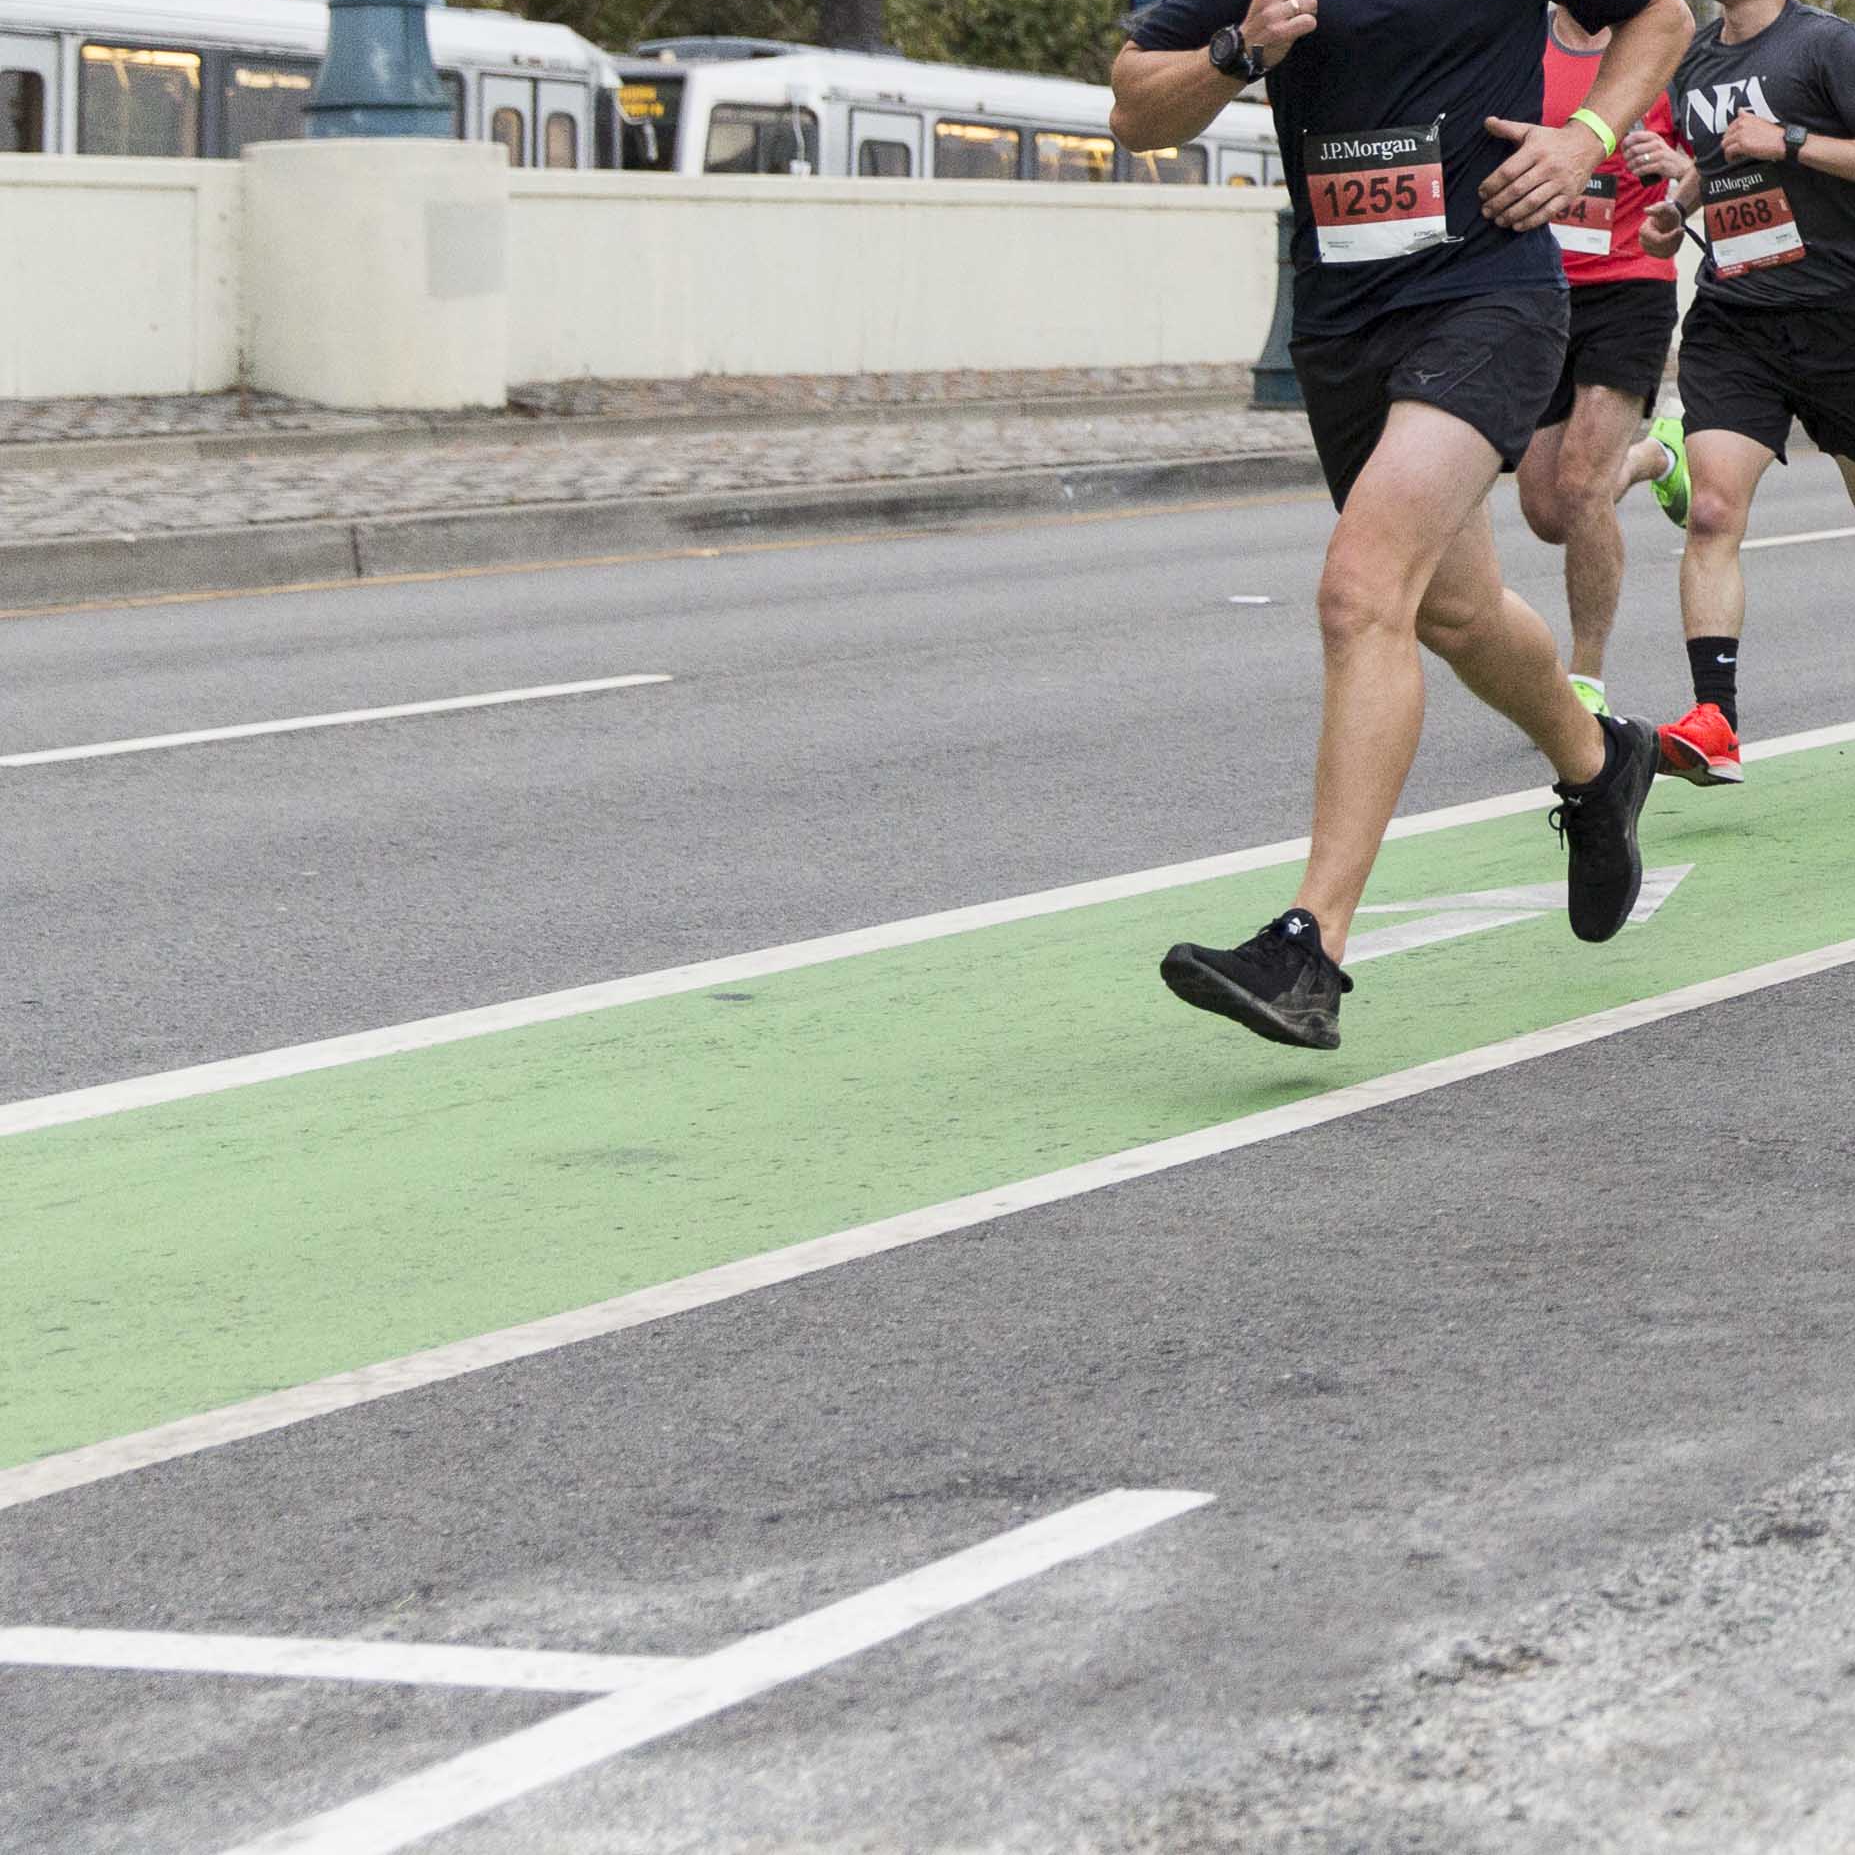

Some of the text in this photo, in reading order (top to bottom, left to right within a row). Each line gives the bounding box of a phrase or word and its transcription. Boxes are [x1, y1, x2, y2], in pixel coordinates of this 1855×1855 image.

[1686, 76, 1781, 141] NFA
[1320, 138, 1417, 161] J.P.Morgan
[1324, 174, 1418, 218] 1255
[1708, 171, 1764, 195] J.P.Morgan
[1714, 199, 1773, 234] 1268
